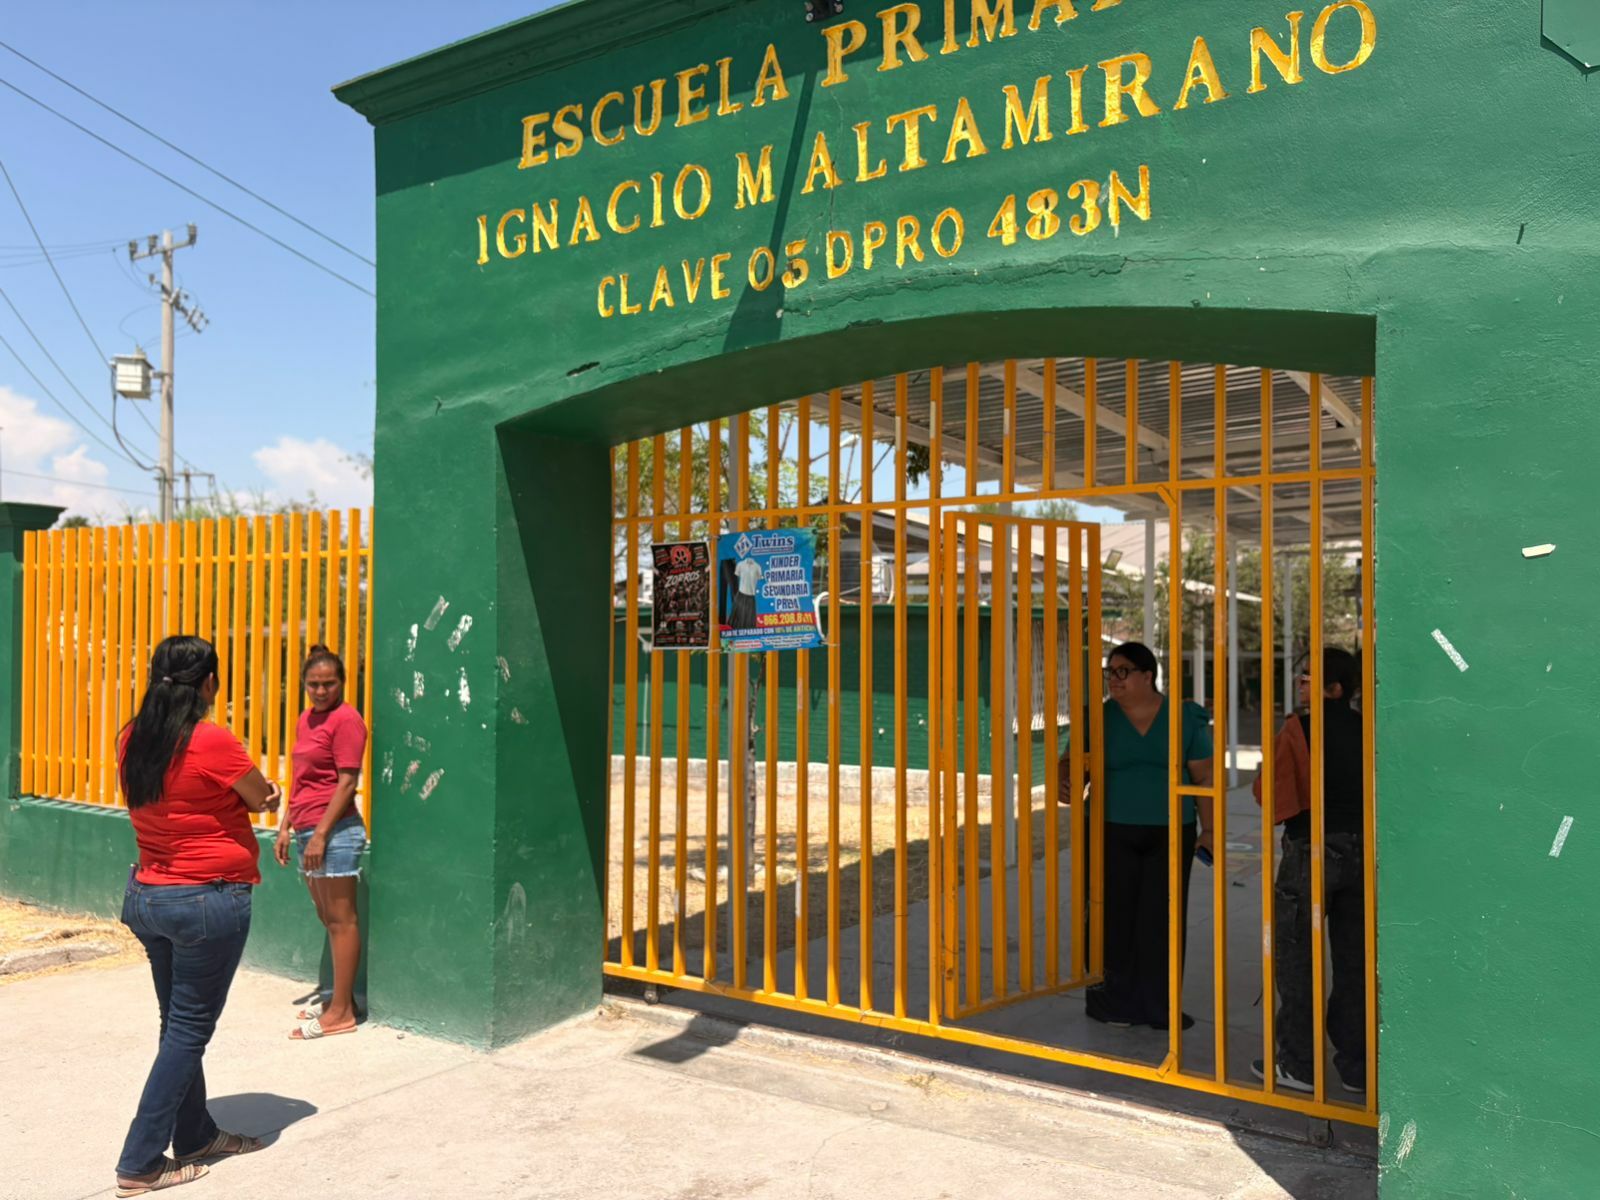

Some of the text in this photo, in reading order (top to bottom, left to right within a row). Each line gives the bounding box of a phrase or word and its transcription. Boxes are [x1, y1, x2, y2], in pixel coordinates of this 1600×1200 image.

[518, 0, 1122, 169] ESCUELA PRIMA
[477, 0, 1377, 265] IGNACIO M ALTAMIRANO
[597, 253, 732, 318] CLAVE
[987, 164, 1152, 245] 483N
[752, 533, 794, 548] Twins
[770, 556, 800, 569] KINDER
[765, 569, 804, 582] PRIMARIA
[763, 583, 809, 597] SECUNDARIA
